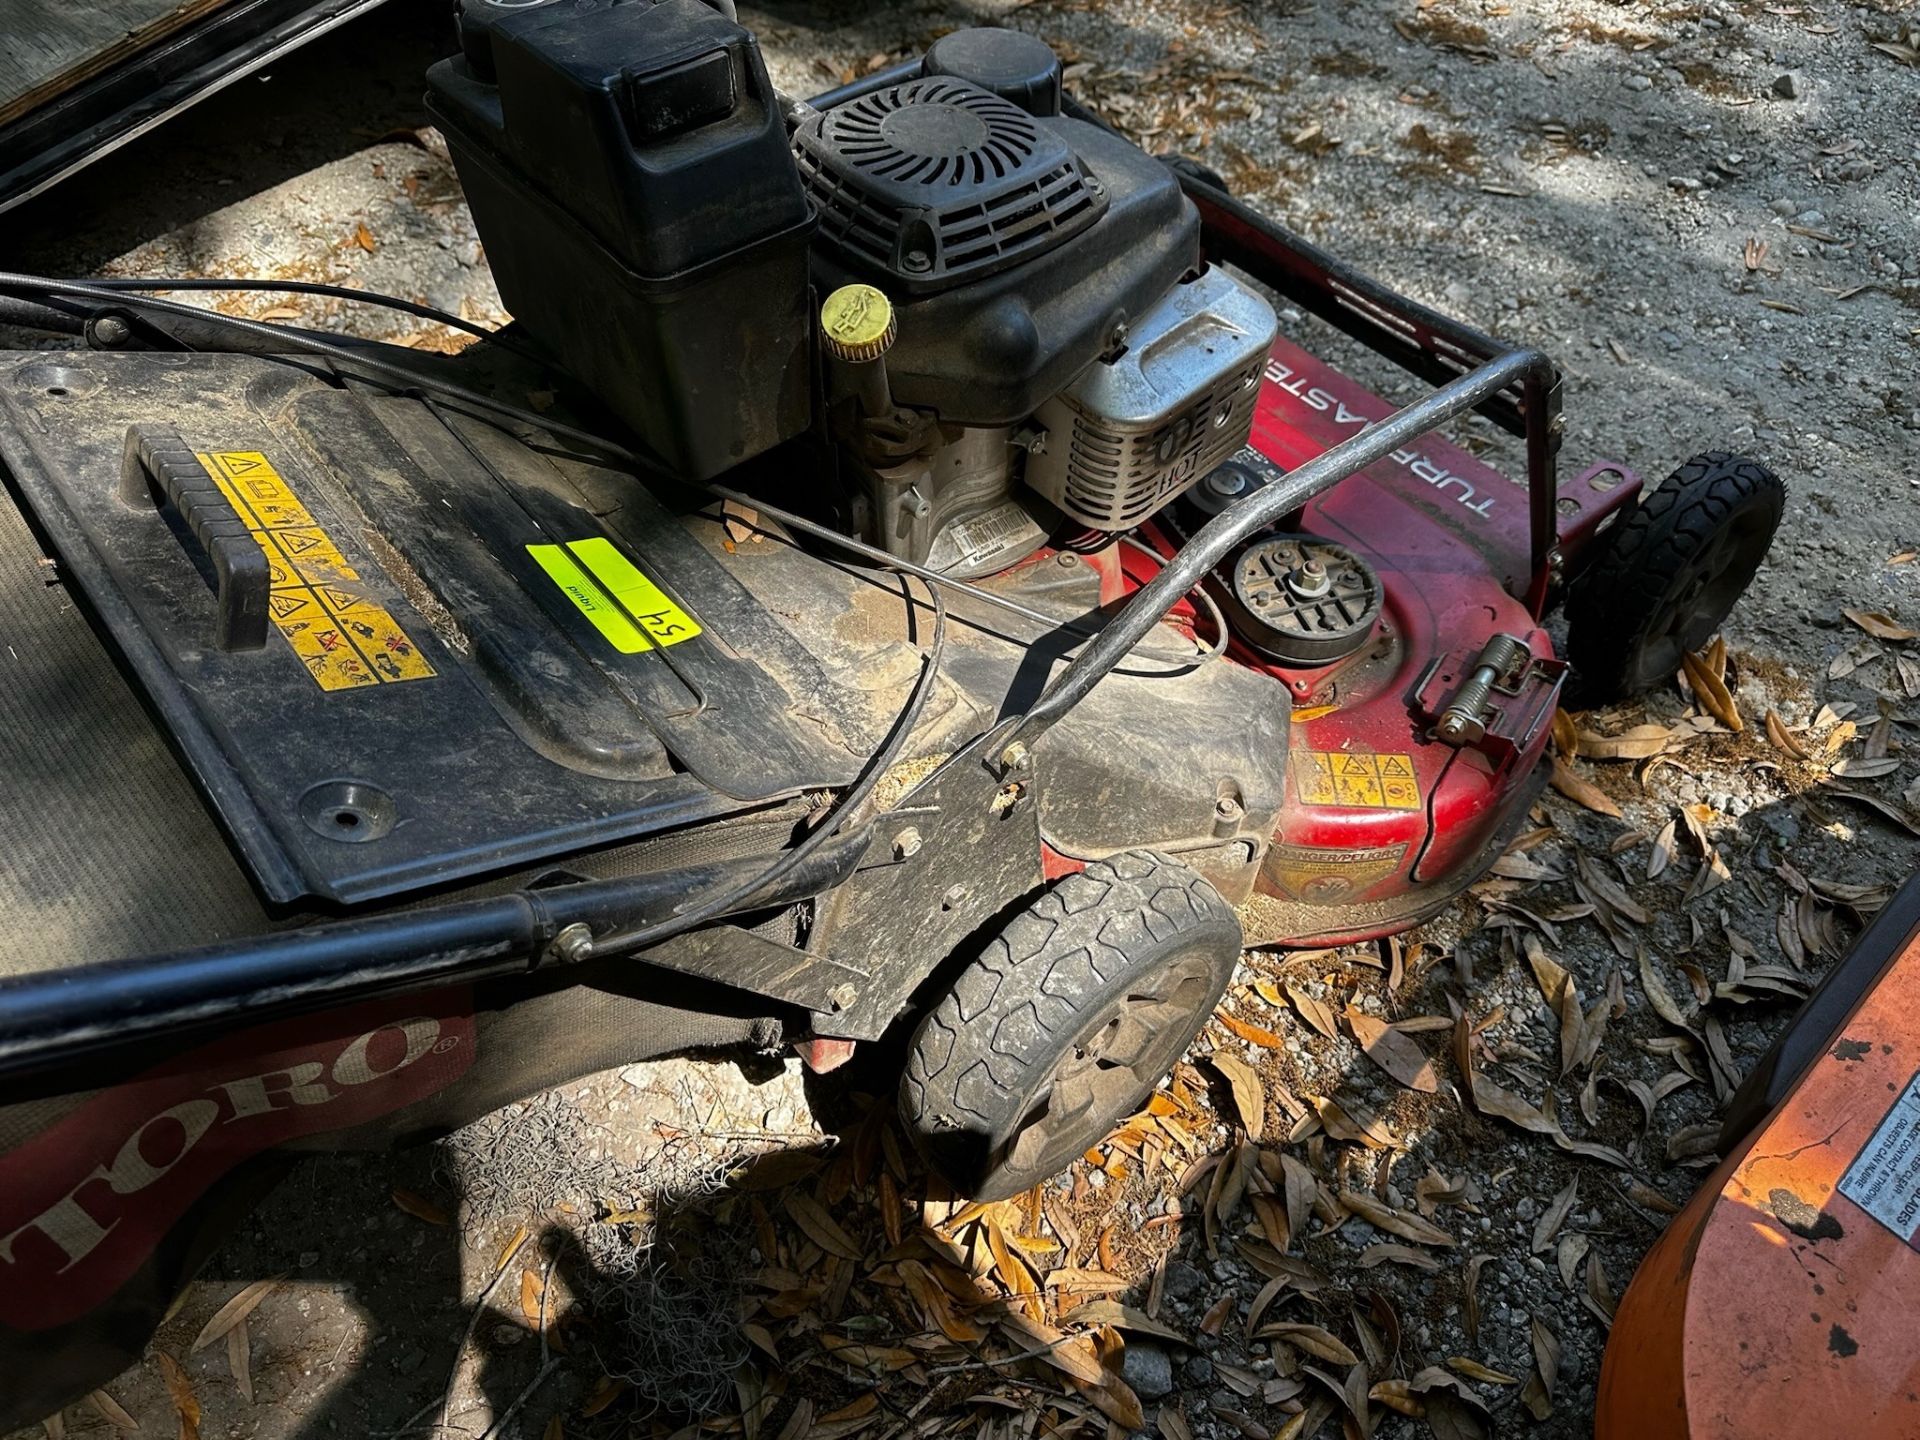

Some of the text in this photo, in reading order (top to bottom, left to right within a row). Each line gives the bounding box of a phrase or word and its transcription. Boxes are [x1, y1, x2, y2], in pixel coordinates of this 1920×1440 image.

[1158, 447, 1203, 494] HOT
[972, 543, 1005, 563] Kawasaki
[566, 585, 597, 612] Liquid
[638, 609, 686, 637] 54
[1854, 1118, 1908, 1189] OBJECTS CAN INJURE
[1885, 1139, 1912, 1173] CONTACT
[1860, 1176, 1887, 1208] THROWN
[1893, 1169, 1913, 1195] CLEAR
